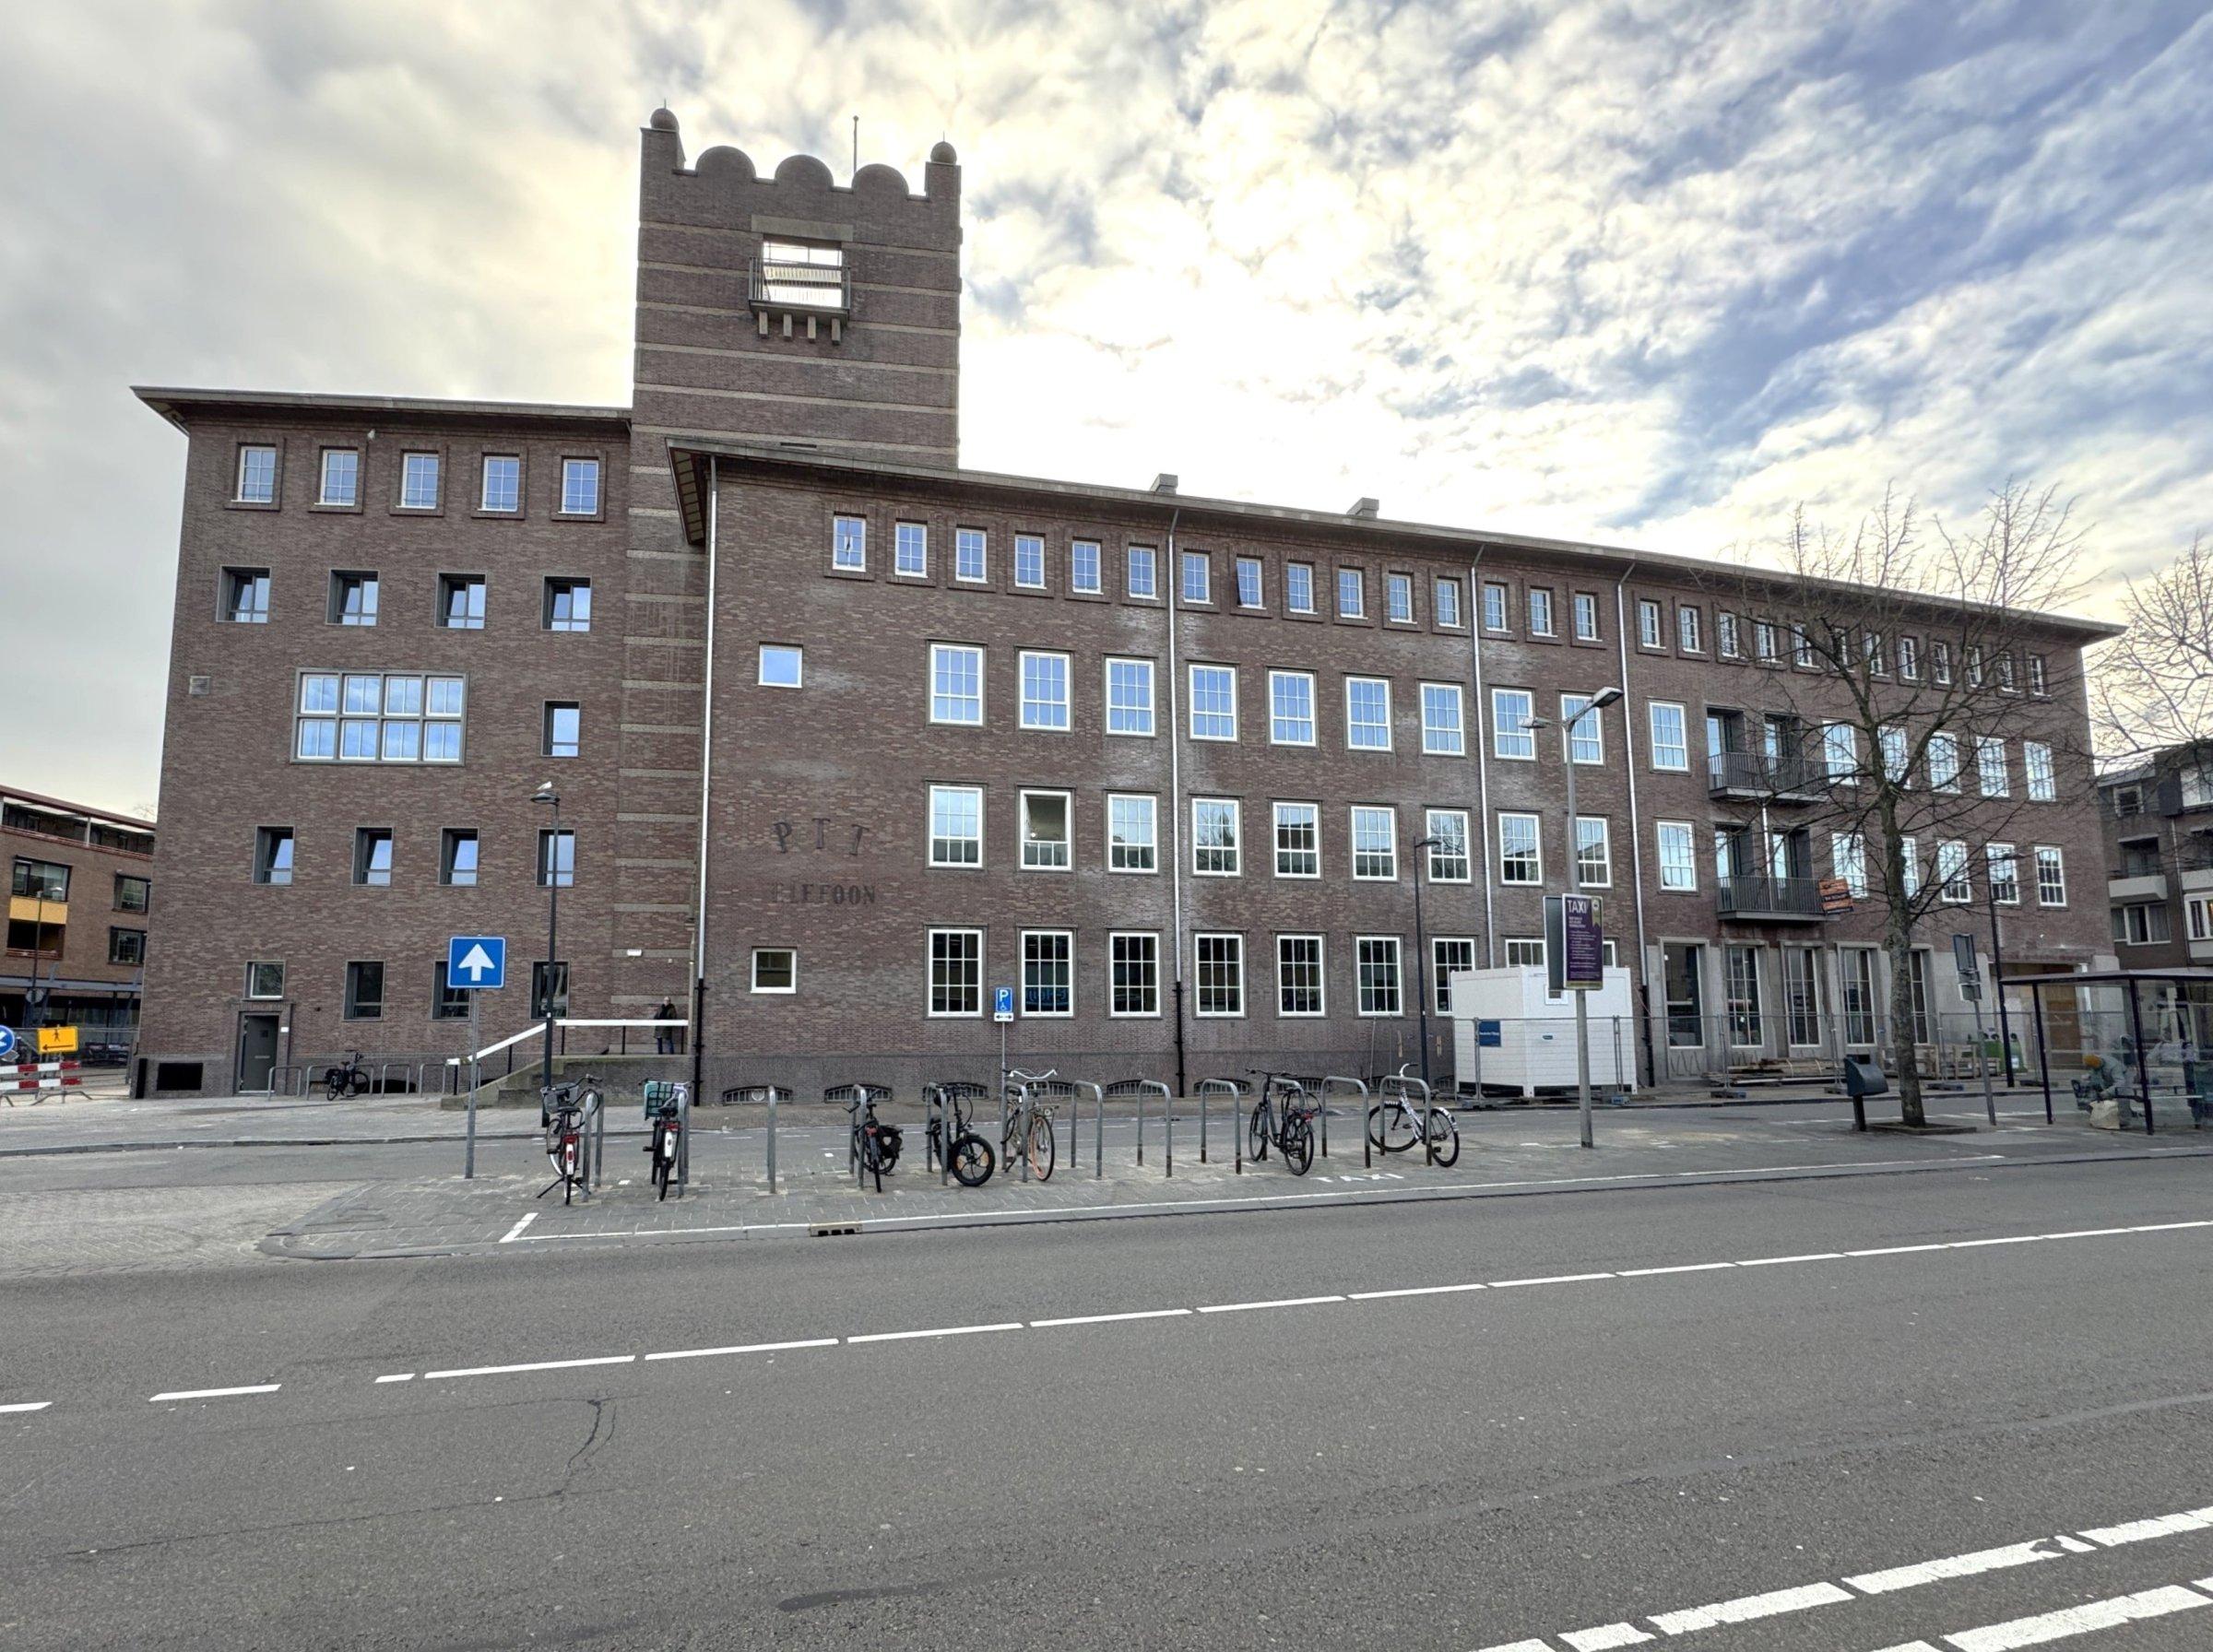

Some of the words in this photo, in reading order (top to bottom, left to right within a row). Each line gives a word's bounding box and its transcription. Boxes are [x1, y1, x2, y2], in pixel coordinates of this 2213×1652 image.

[1567, 899, 1588, 914] TAXI
[999, 989, 1009, 1002] P
[1309, 1173, 1405, 1183] TAXI
